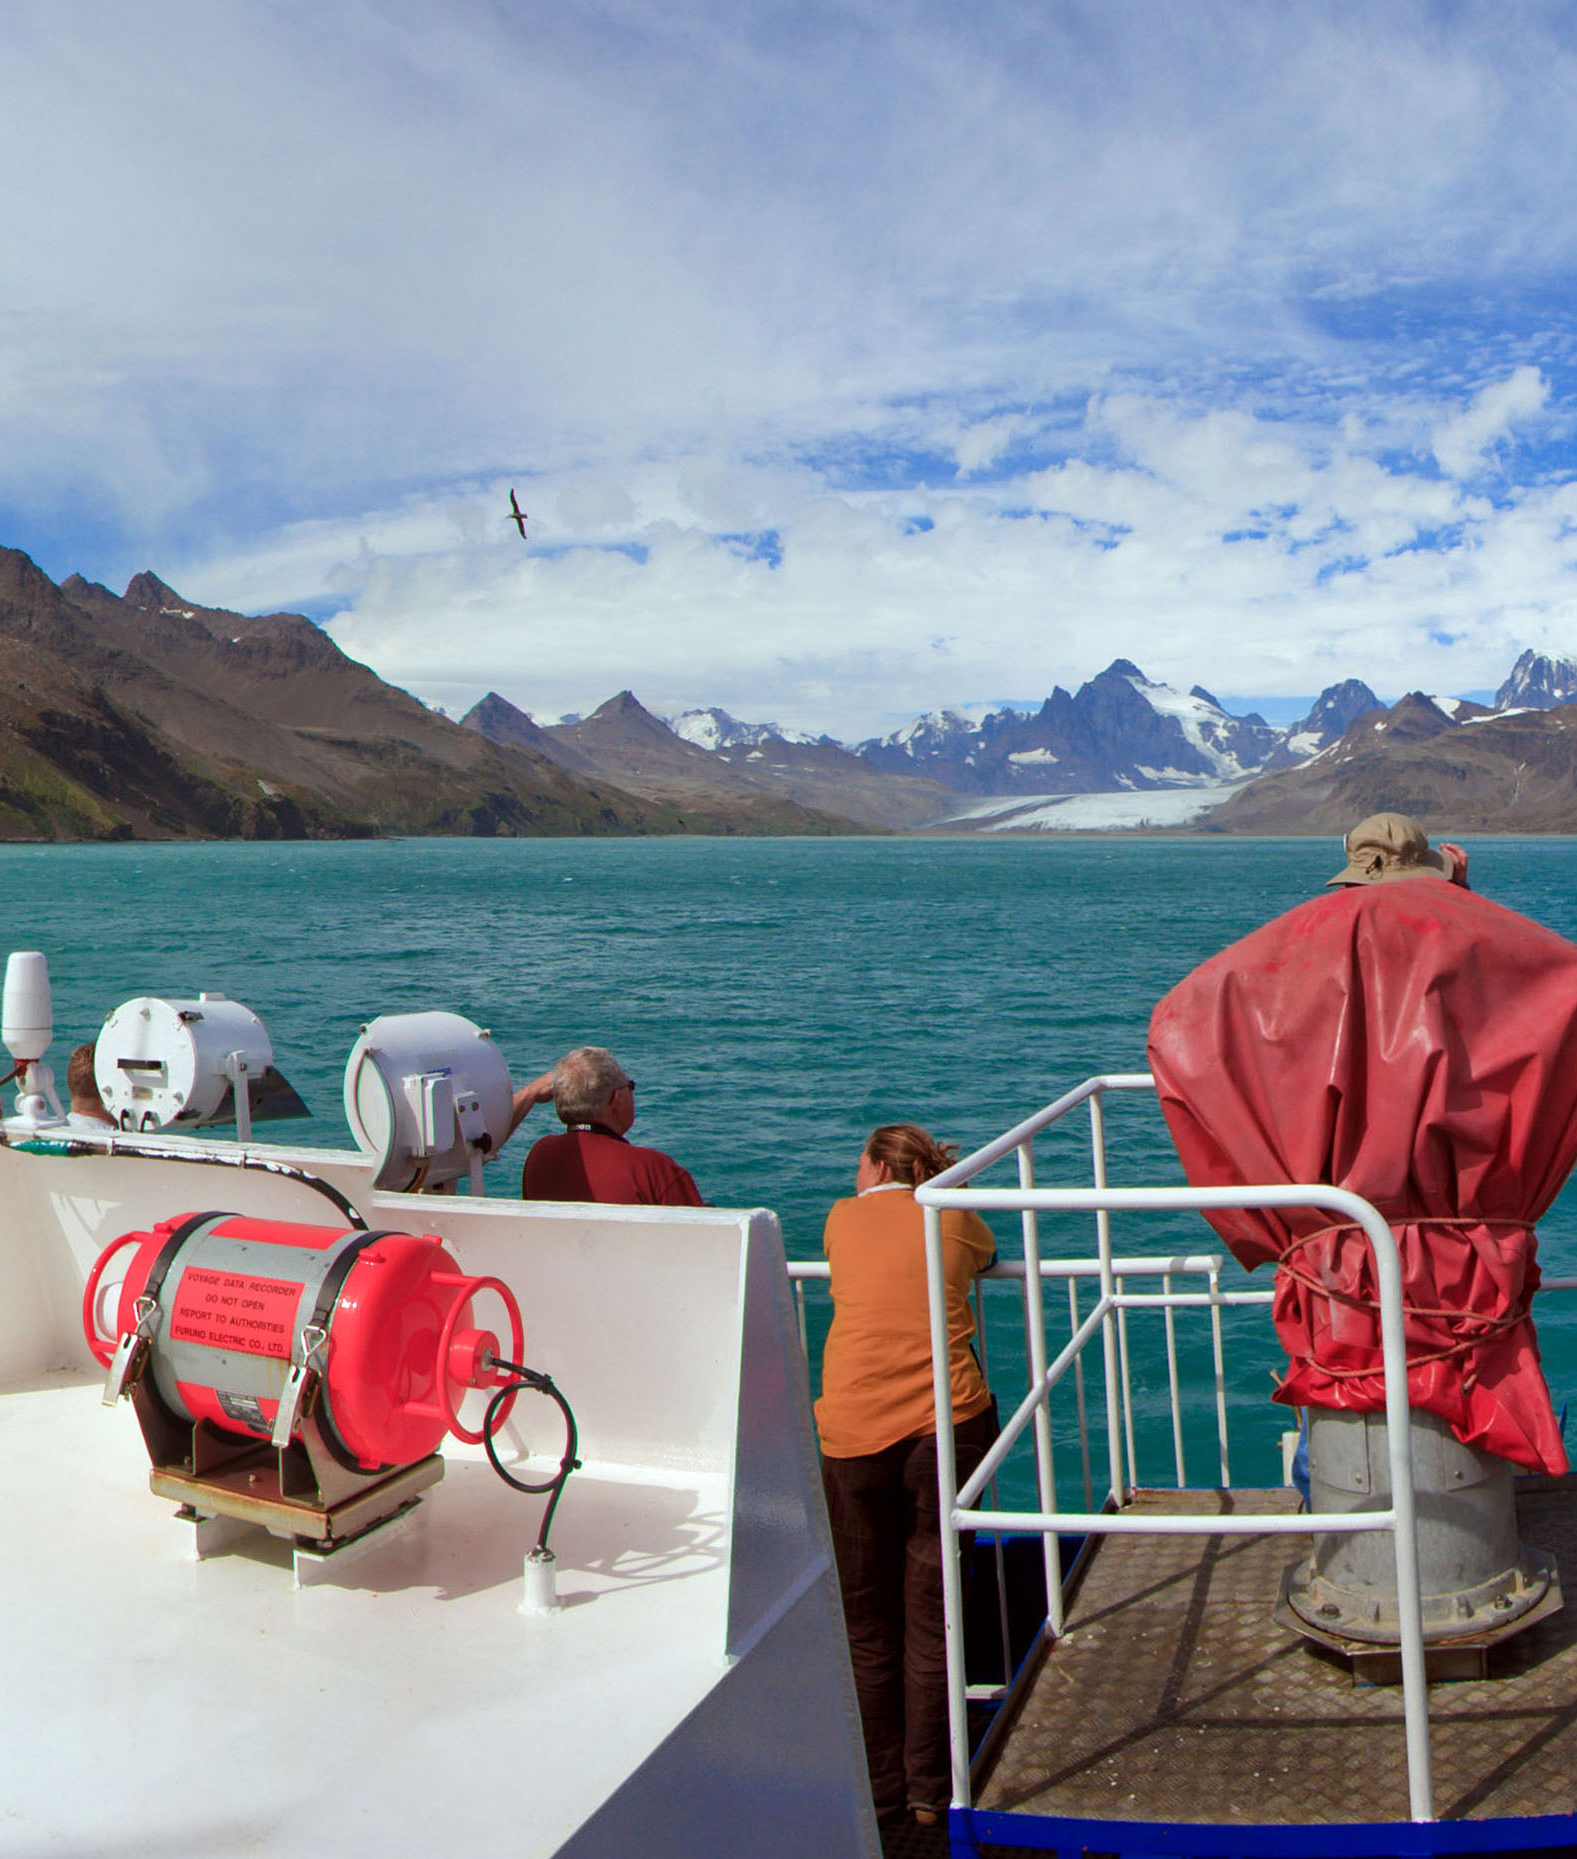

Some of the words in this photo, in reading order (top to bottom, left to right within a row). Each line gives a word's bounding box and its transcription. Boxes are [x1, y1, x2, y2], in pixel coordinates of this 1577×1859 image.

[188, 1273, 220, 1286] VOYAGE
[223, 1278, 244, 1288] DATA
[249, 1282, 296, 1296] RECORDER
[205, 1294, 218, 1303] DO
[221, 1296, 238, 1306] NOT
[242, 1300, 265, 1311] OPEN
[180, 1308, 212, 1320] REPORT
[216, 1315, 227, 1323] TO
[230, 1317, 285, 1333] AUTHORITIES
[175, 1326, 206, 1339] FURUNO
[209, 1332, 246, 1347] ELECTRIC
